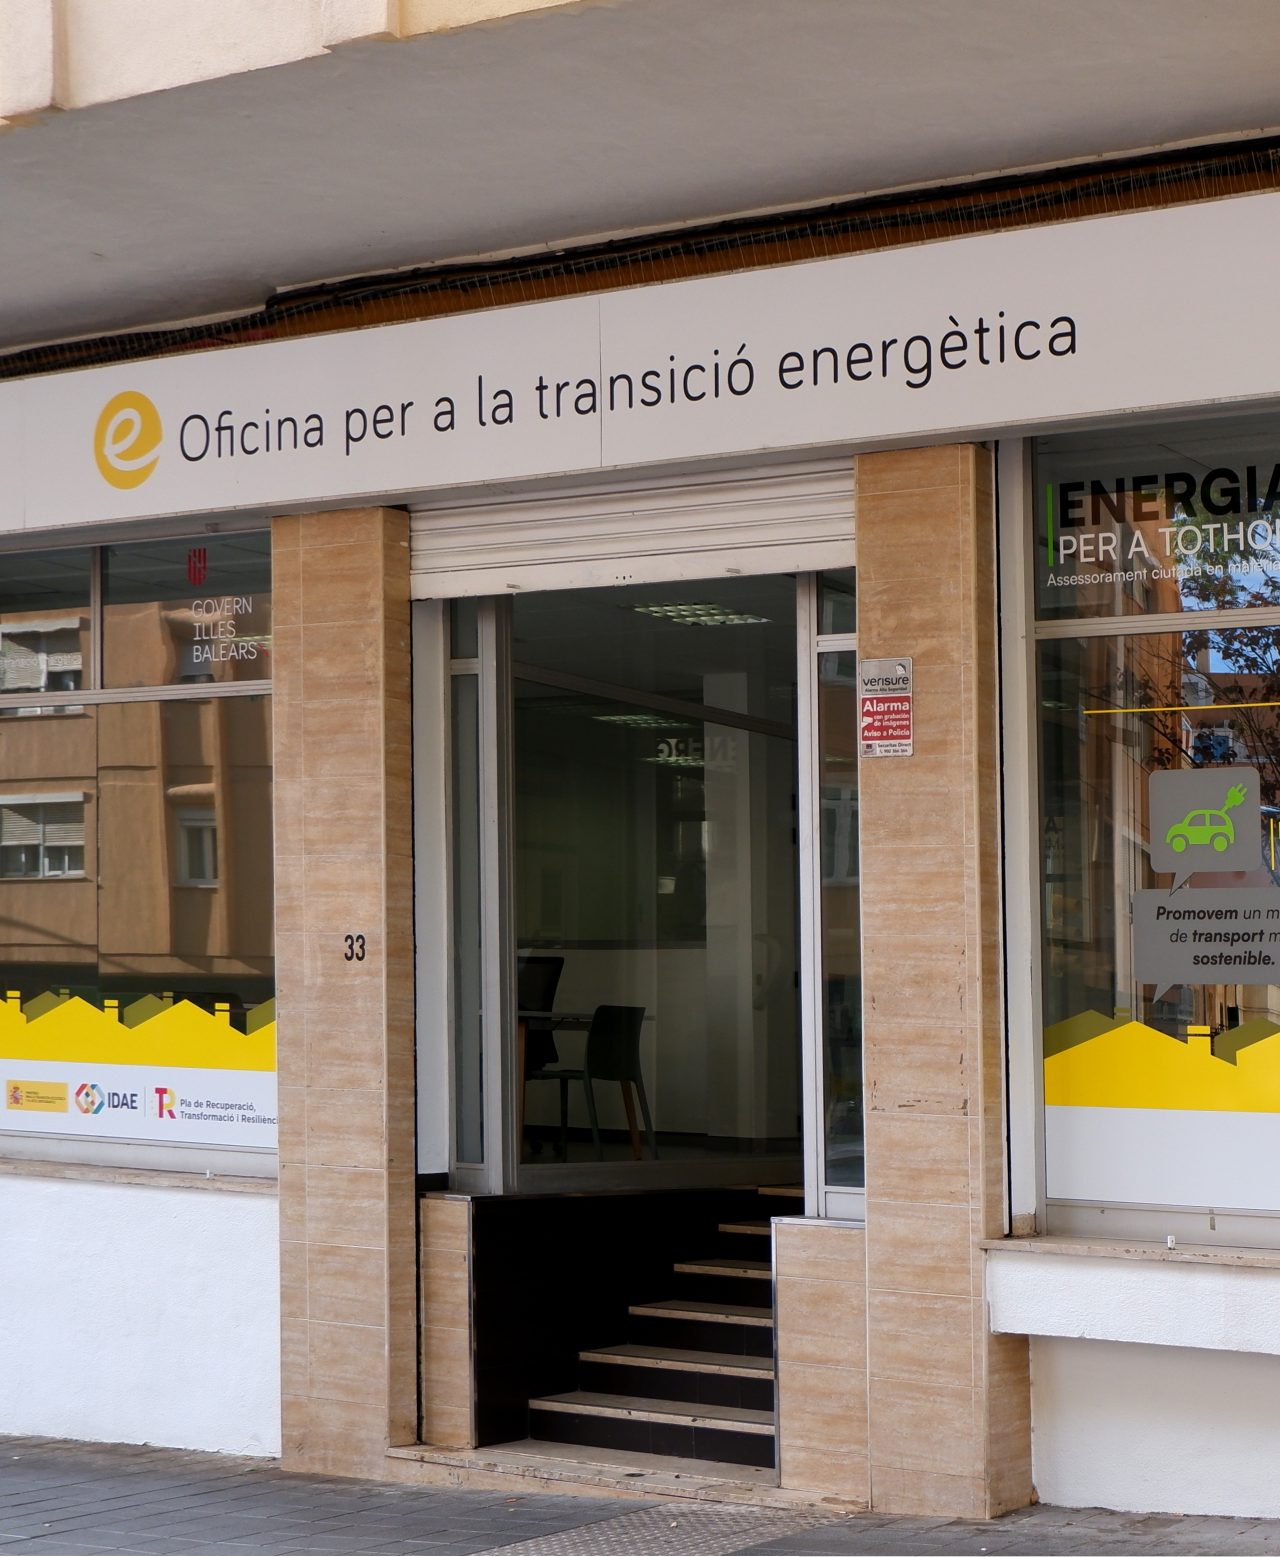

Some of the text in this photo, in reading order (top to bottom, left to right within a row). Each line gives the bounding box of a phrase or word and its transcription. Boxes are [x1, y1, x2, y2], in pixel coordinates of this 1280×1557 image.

[180, 408, 324, 462] Oficina
[345, 397, 415, 457] per
[433, 395, 456, 432] a
[477, 374, 515, 427] la
[536, 343, 755, 420] transició
[778, 310, 1079, 389] energètica
[1060, 531, 1118, 565] PER
[1127, 530, 1150, 560] A
[1047, 568, 1148, 587] Assessorament
[1206, 564, 1225, 576] en
[192, 597, 253, 618] GOVERN
[193, 620, 236, 641] ILLES
[862, 676, 910, 687] verisure
[863, 699, 910, 713] Alarma
[873, 719, 882, 727] de
[863, 729, 882, 737] Aviso
[889, 728, 910, 736] Policía
[1156, 905, 1239, 921] Promovem
[1243, 907, 1261, 921] un
[1169, 928, 1188, 944] de
[1192, 928, 1265, 947] transport
[344, 933, 366, 962] 33
[1193, 950, 1276, 966] sostenible.
[107, 1092, 138, 1110] IDAE
[180, 1098, 256, 1112] Pla de Recuperació,
[180, 1110, 235, 1122] Transformació
